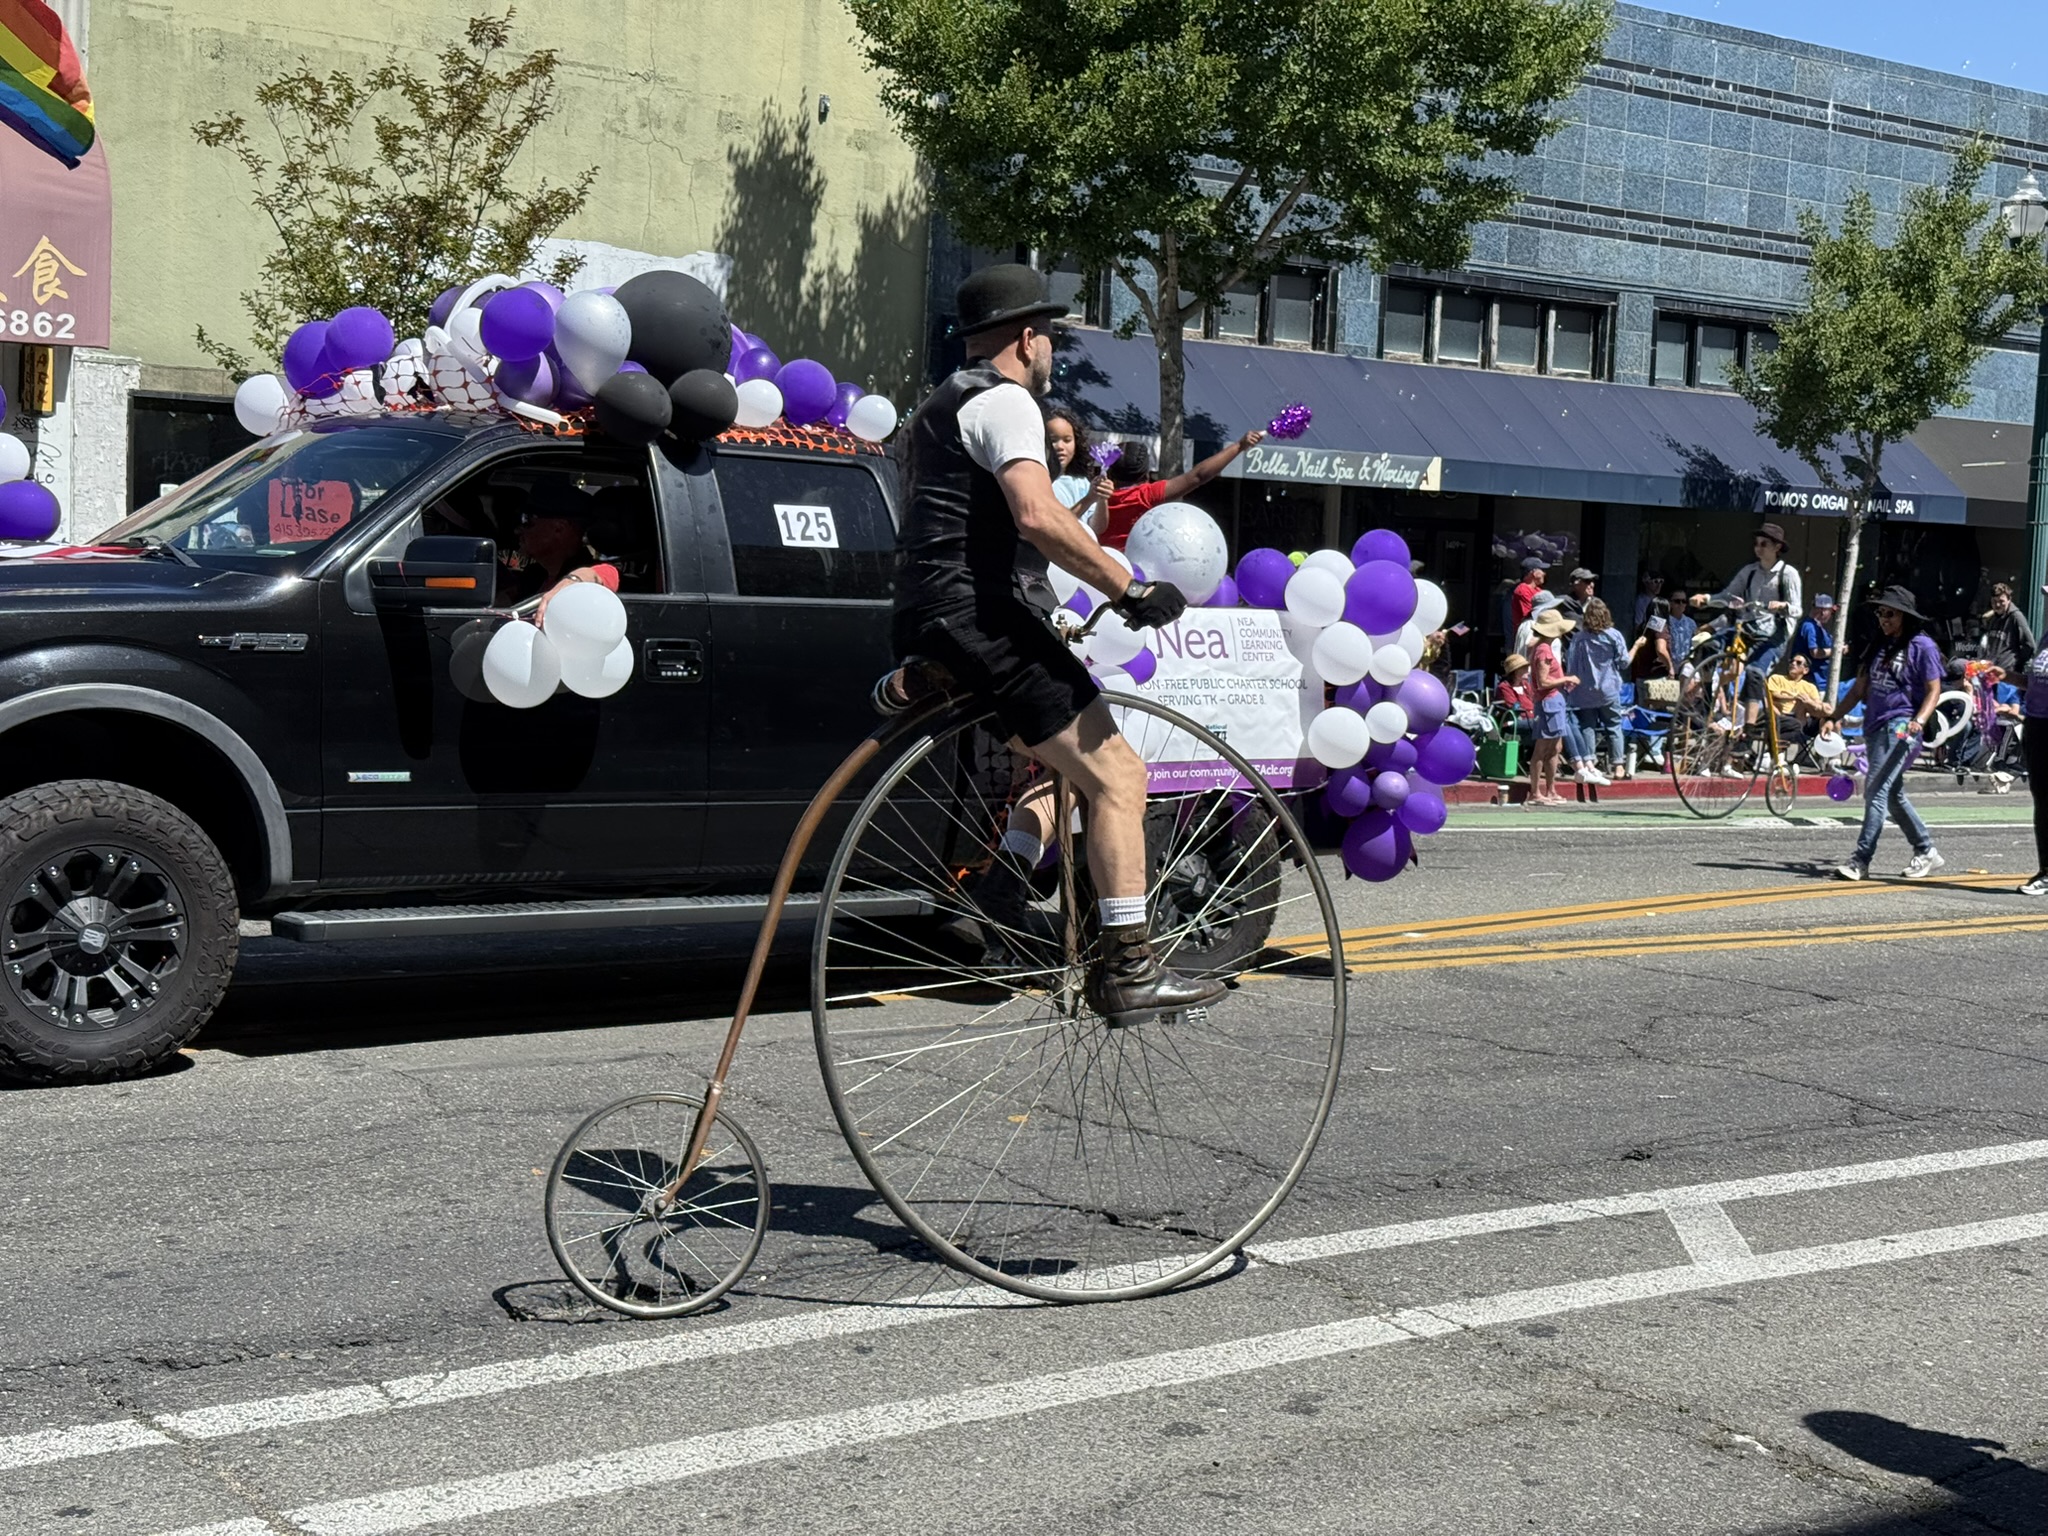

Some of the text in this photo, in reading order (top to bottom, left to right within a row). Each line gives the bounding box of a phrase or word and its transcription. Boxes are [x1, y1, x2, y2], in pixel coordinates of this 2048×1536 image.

[0, 235, 88, 306] 食
[1246, 447, 1289, 475] Bella
[1290, 451, 1326, 478] Nail
[1328, 457, 1355, 482] Spa
[1357, 456, 1371, 481] &
[1765, 491, 1808, 508] TOMO'S
[1867, 499, 1891, 513] NAIL
[1894, 499, 1915, 514] SPA
[781, 511, 832, 543] 125
[1237, 617, 1255, 627] NEA
[1156, 619, 1229, 660] Nea
[1239, 628, 1292, 638] COMMUNITY
[1241, 640, 1283, 650] LEARNING
[1242, 652, 1275, 662] CENTER
[1190, 679, 1225, 690] PUBLIC
[1227, 678, 1269, 690] CHARTER
[1269, 679, 1308, 690] SCHOOL
[1157, 695, 1202, 706] SERVING
[1203, 694, 1218, 705] TK
[1227, 694, 1258, 705] GRADE
[1153, 768, 1171, 782] join
[1172, 769, 1188, 778] our
[1251, 764, 1294, 777] EAclc.org
